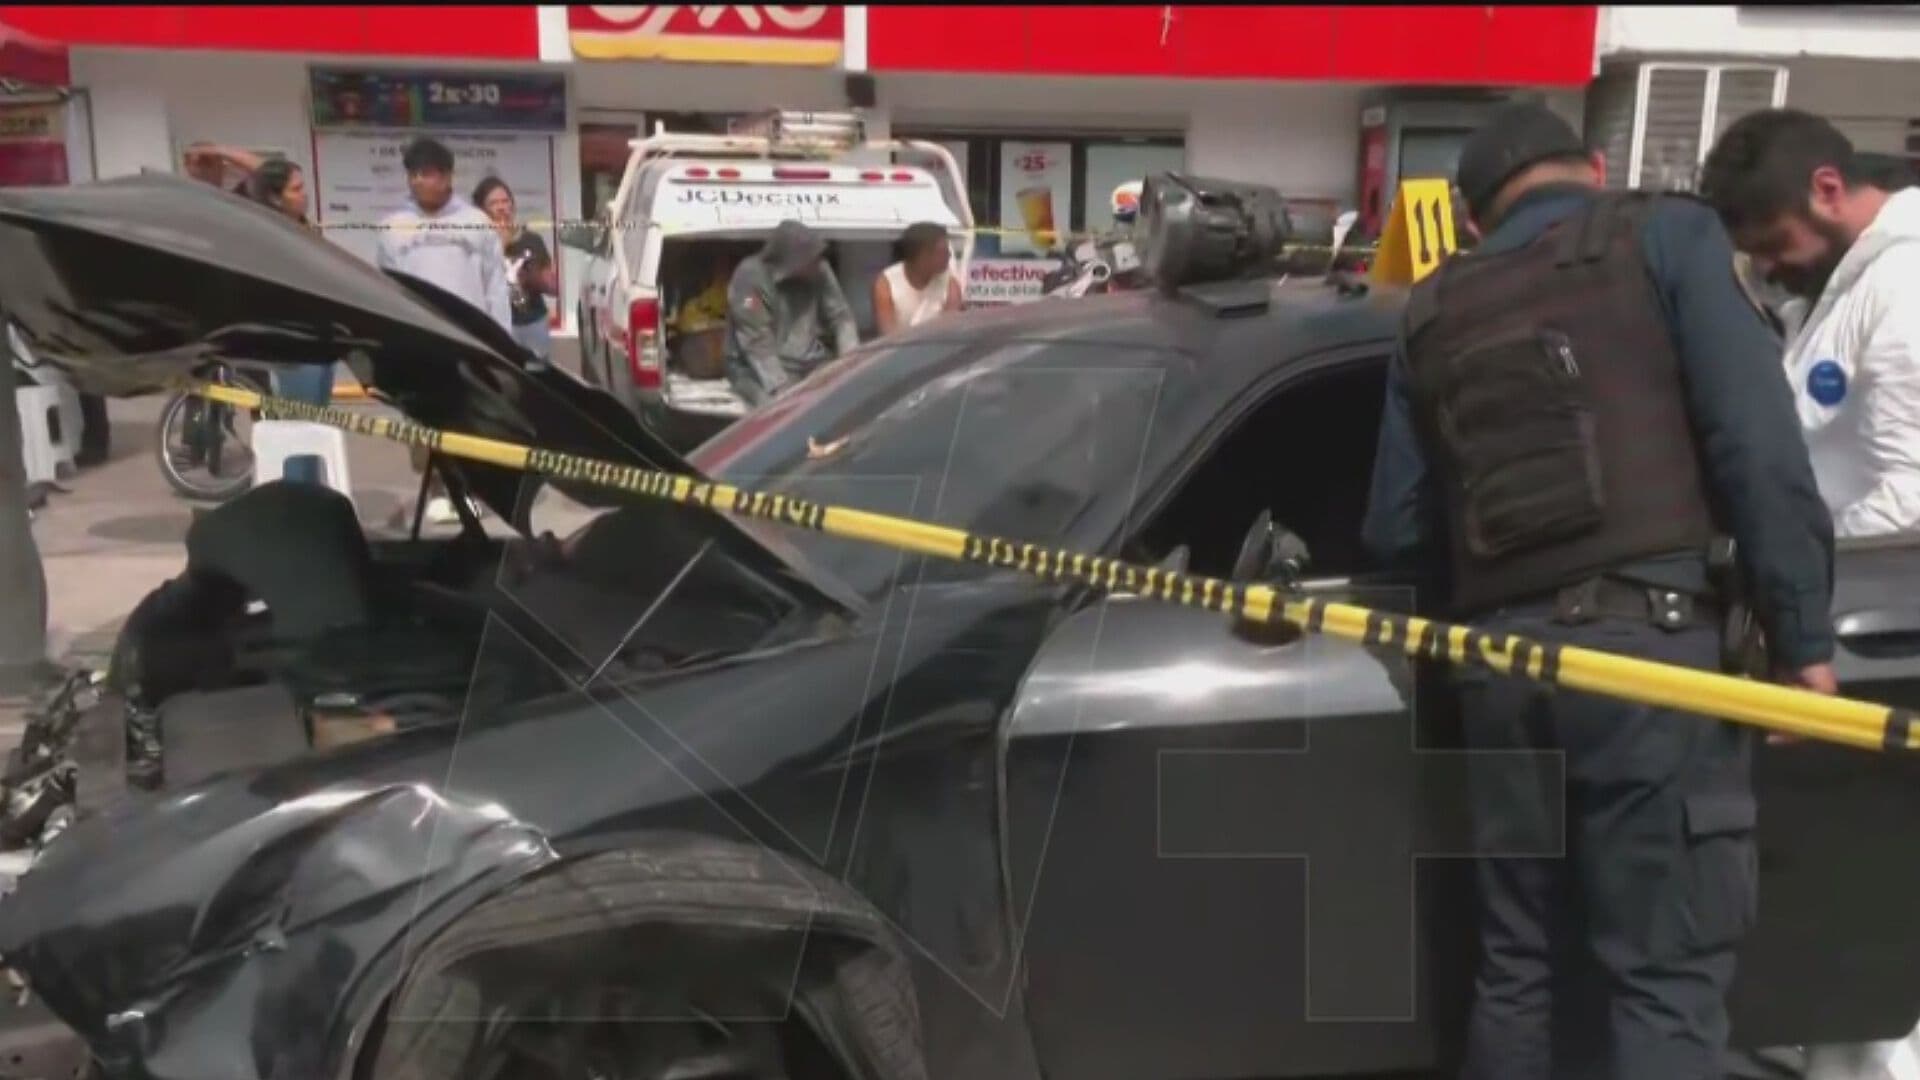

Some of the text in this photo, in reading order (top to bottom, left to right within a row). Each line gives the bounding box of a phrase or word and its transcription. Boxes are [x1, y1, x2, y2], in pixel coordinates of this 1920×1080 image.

[677, 189, 840, 206] JCDecaux
[1414, 196, 1449, 264] 11
[969, 263, 1046, 283] efectivo
